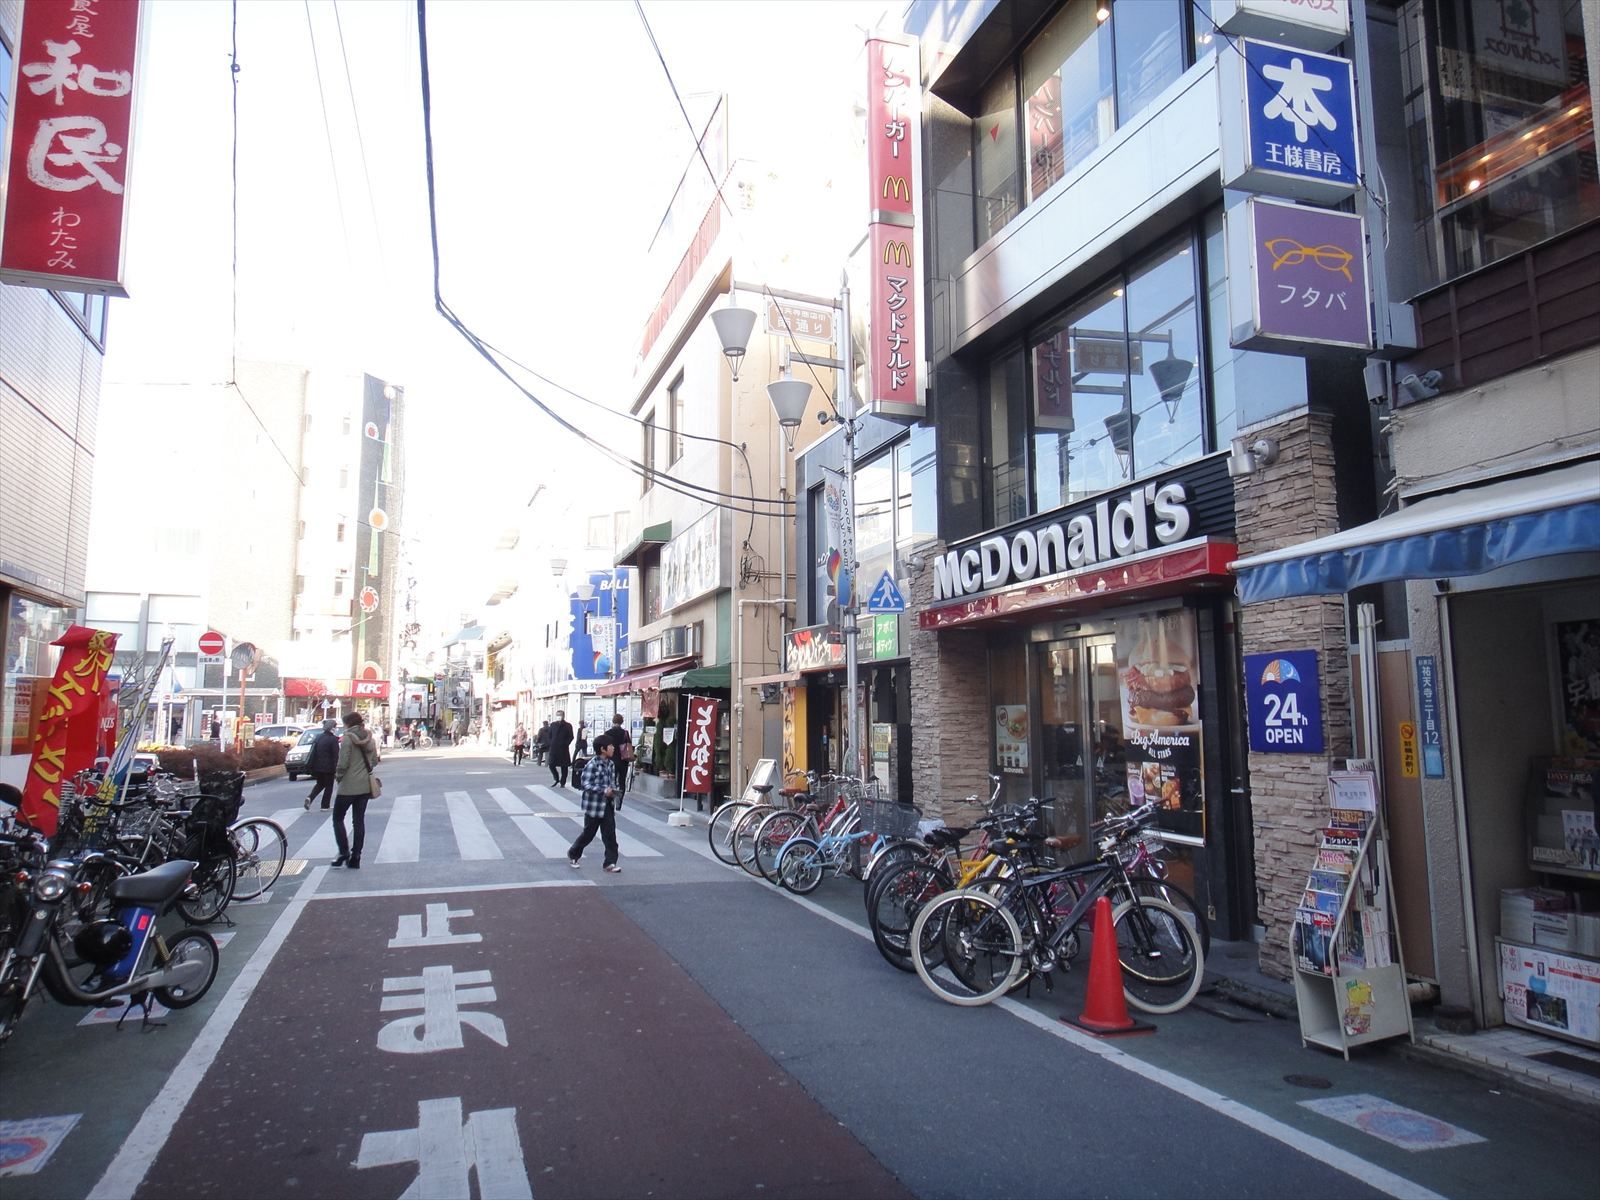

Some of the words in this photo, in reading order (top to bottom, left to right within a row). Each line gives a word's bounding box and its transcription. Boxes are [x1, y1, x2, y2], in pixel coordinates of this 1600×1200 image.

[22, 39, 132, 195] 和民
[1262, 57, 1337, 143] 本
[1264, 141, 1342, 175] 王様書房
[47, 206, 81, 269] わたみ
[1277, 284, 1347, 310] フタバ
[886, 275, 911, 390] マクドナルド
[934, 481, 1190, 600] McDonald's
[356, 683, 383, 694] KFC
[1131, 728, 1148, 750] Big
[1148, 728, 1190, 746] America
[1265, 728, 1304, 744] OPEN
[1424, 731, 1439, 744] 12
